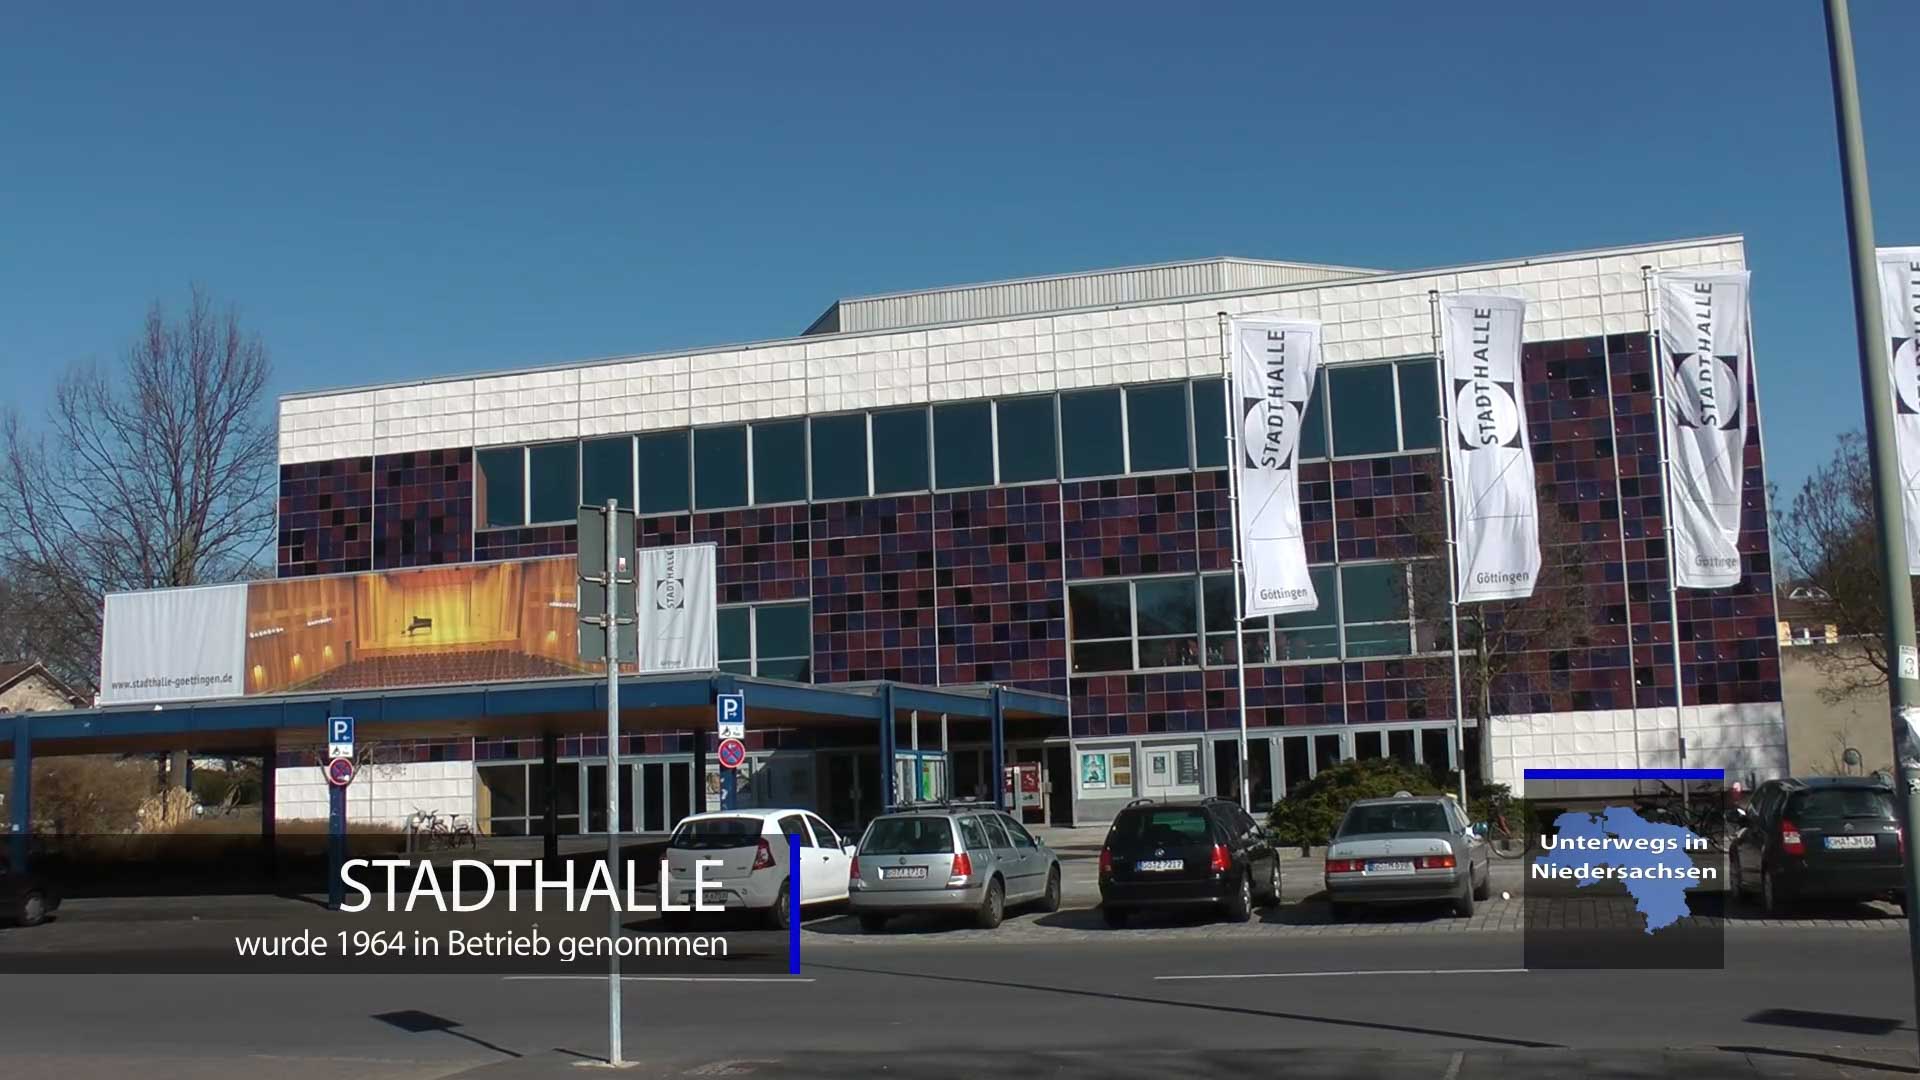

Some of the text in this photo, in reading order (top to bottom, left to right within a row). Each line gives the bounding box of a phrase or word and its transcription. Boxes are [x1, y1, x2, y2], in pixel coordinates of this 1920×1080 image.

[1694, 282, 1717, 426] STADTHALLE
[1473, 308, 1498, 445] STADTHALLE
[1261, 330, 1285, 468] STADTHALLE
[1476, 571, 1529, 585] Göttingen
[1260, 587, 1308, 600] Göttingen
[111, 673, 233, 690] www.stadthalle-goettingen.de
[724, 699, 738, 720] P
[334, 721, 348, 741] P
